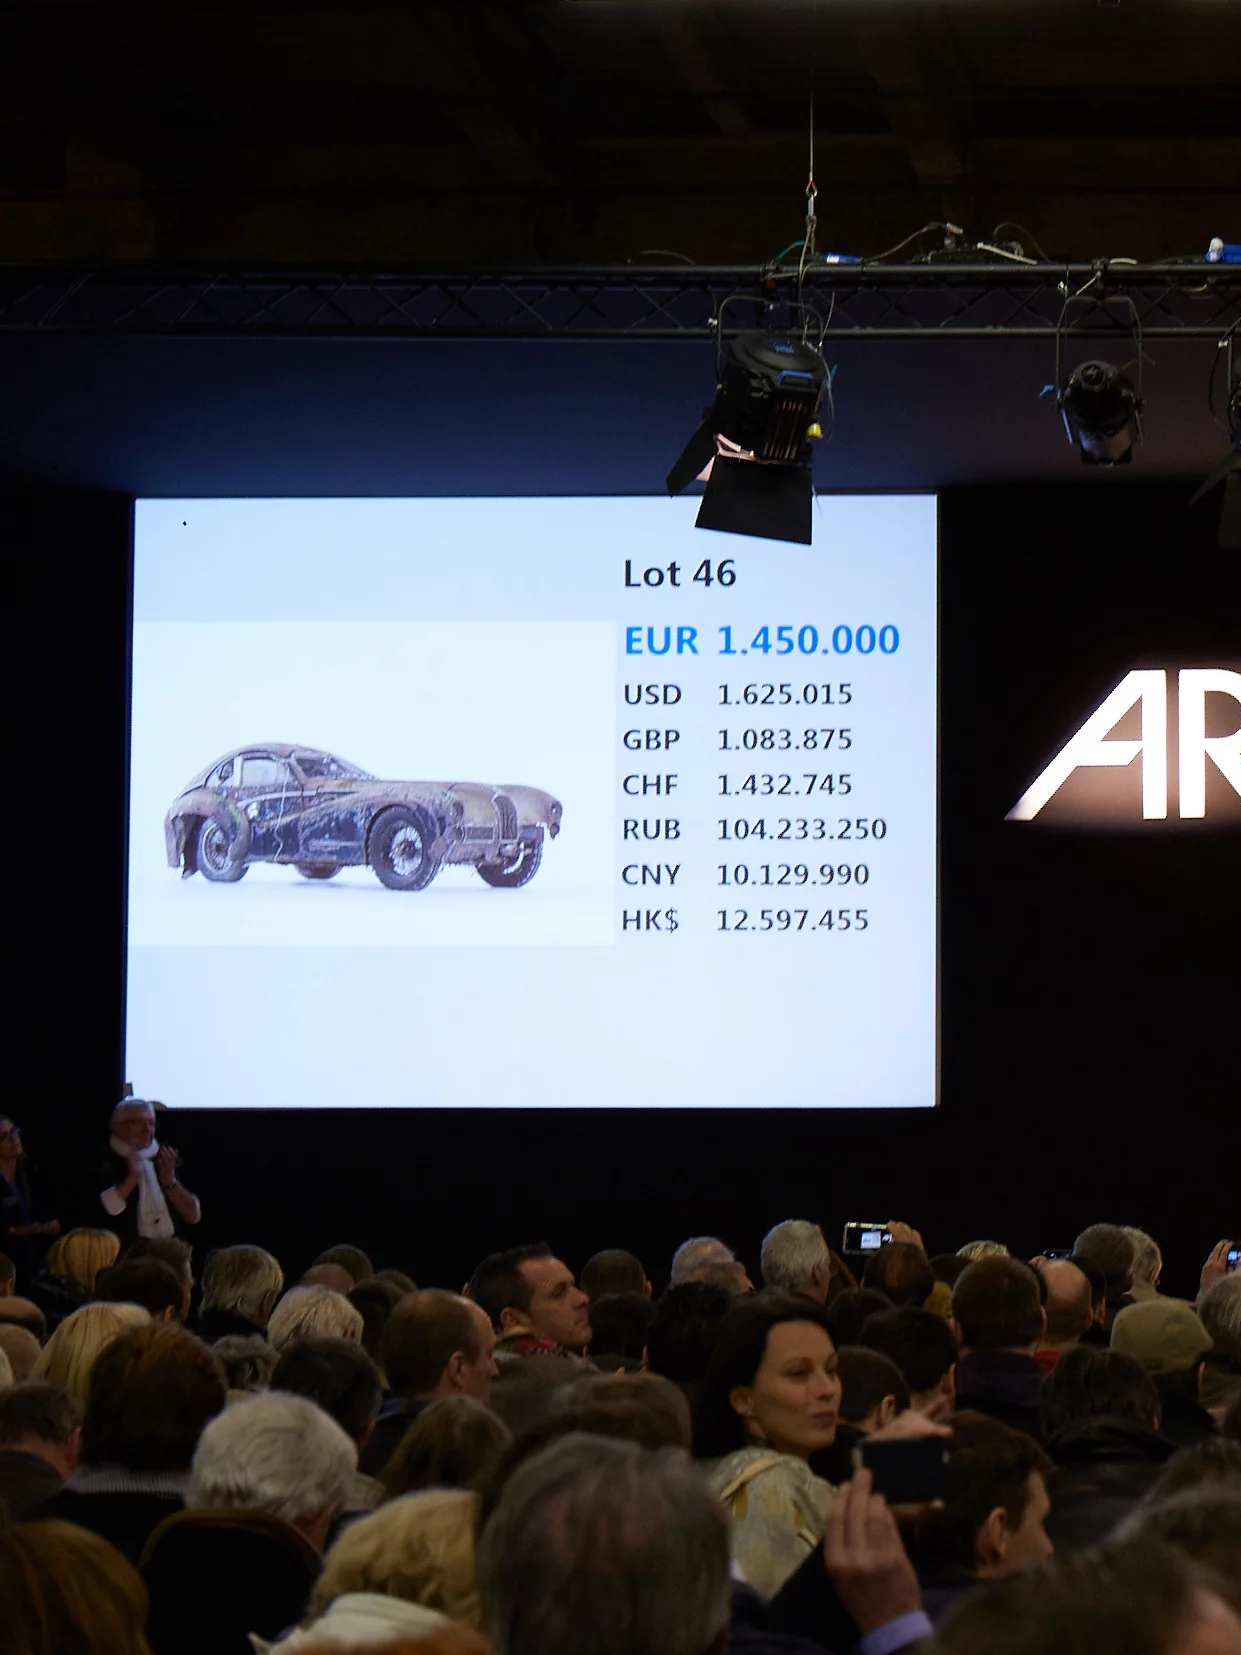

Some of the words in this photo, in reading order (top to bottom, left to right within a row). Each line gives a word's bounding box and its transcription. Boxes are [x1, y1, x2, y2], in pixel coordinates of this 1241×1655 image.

[624, 559, 681, 588] Lot
[692, 559, 737, 588] 46
[625, 626, 699, 656] EUR
[717, 624, 900, 656] 1.450.000
[624, 684, 682, 705] USD
[718, 683, 853, 705] 1.625.015
[622, 729, 681, 751] GBP
[718, 728, 853, 751] 1.083.875
[622, 774, 678, 796] CHF
[718, 774, 853, 796] 1.432.745
[623, 819, 681, 840] RUB
[717, 818, 887, 840] 104.233.250
[621, 864, 681, 885] CNY
[717, 863, 869, 885] 10.129.990
[622, 907, 679, 934] HK$
[717, 909, 869, 931] 12.597.455
